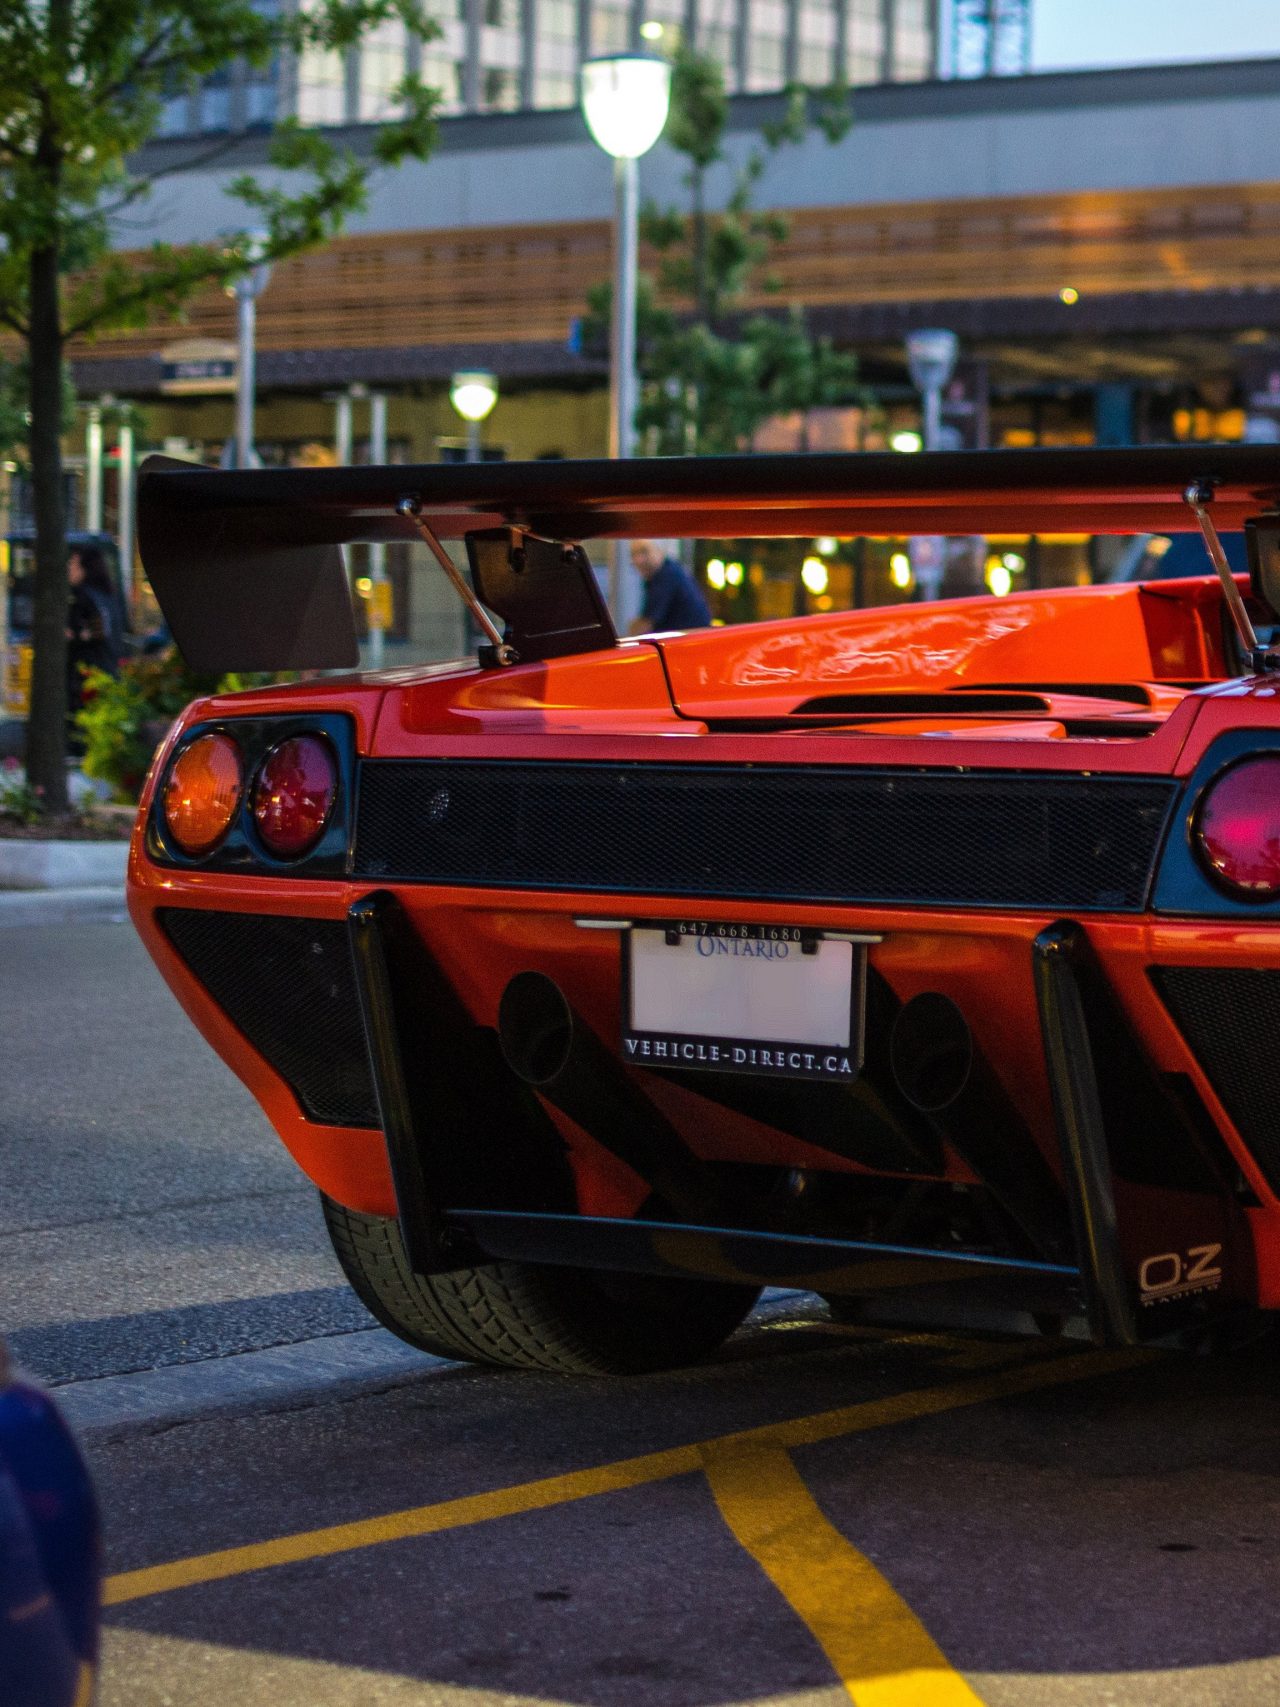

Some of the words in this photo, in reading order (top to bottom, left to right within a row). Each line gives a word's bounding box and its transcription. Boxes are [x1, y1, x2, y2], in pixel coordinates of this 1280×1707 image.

[679, 922, 801, 940] 647.668.1680
[697, 936, 789, 960] ONTARIO
[626, 1039, 852, 1073] VEHICLE-DIRECT.CA
